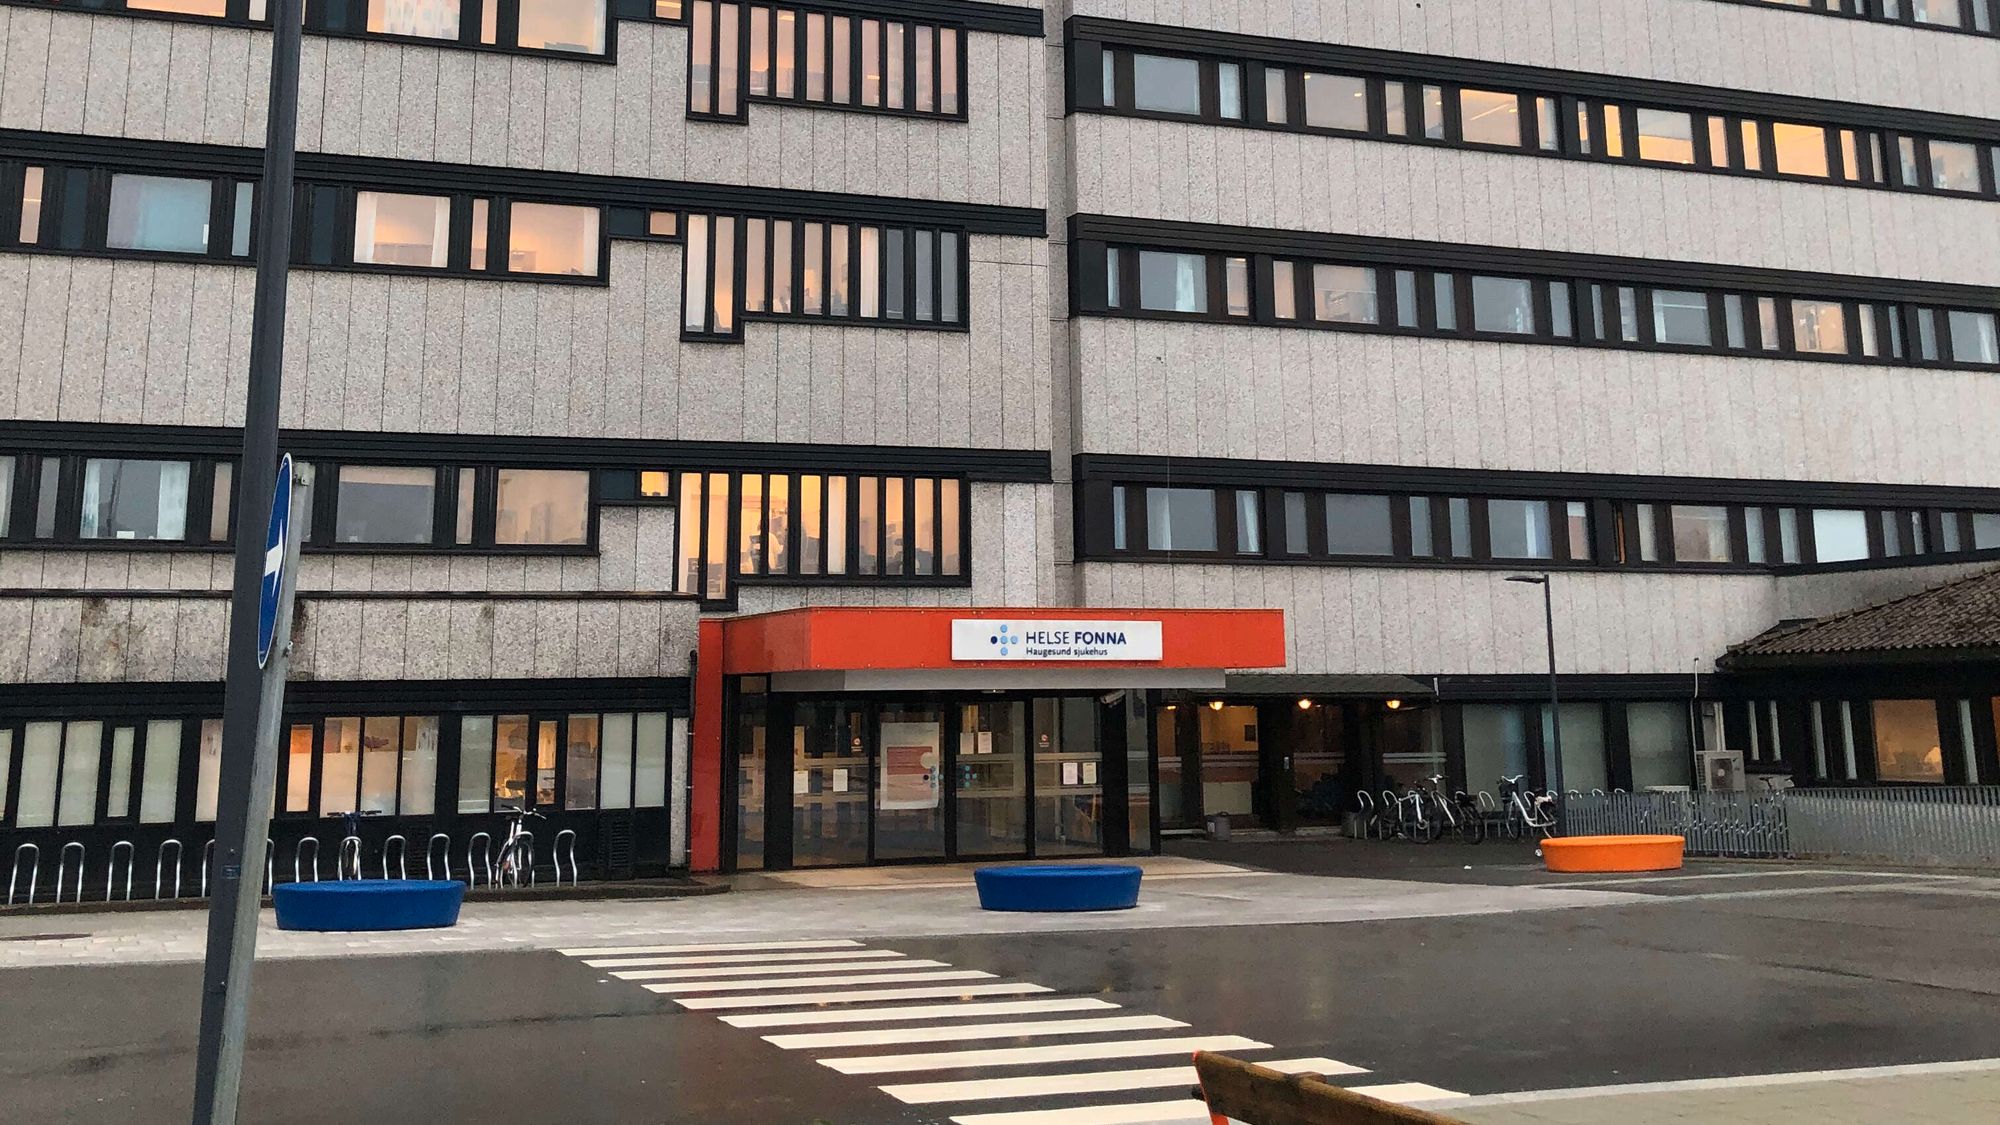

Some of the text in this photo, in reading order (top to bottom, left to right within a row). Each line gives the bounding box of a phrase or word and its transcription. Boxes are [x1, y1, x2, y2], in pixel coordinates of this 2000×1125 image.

[1026, 631, 1127, 645] HELSE FONNA
[1026, 647, 1108, 657] Haugesund sjukehus
